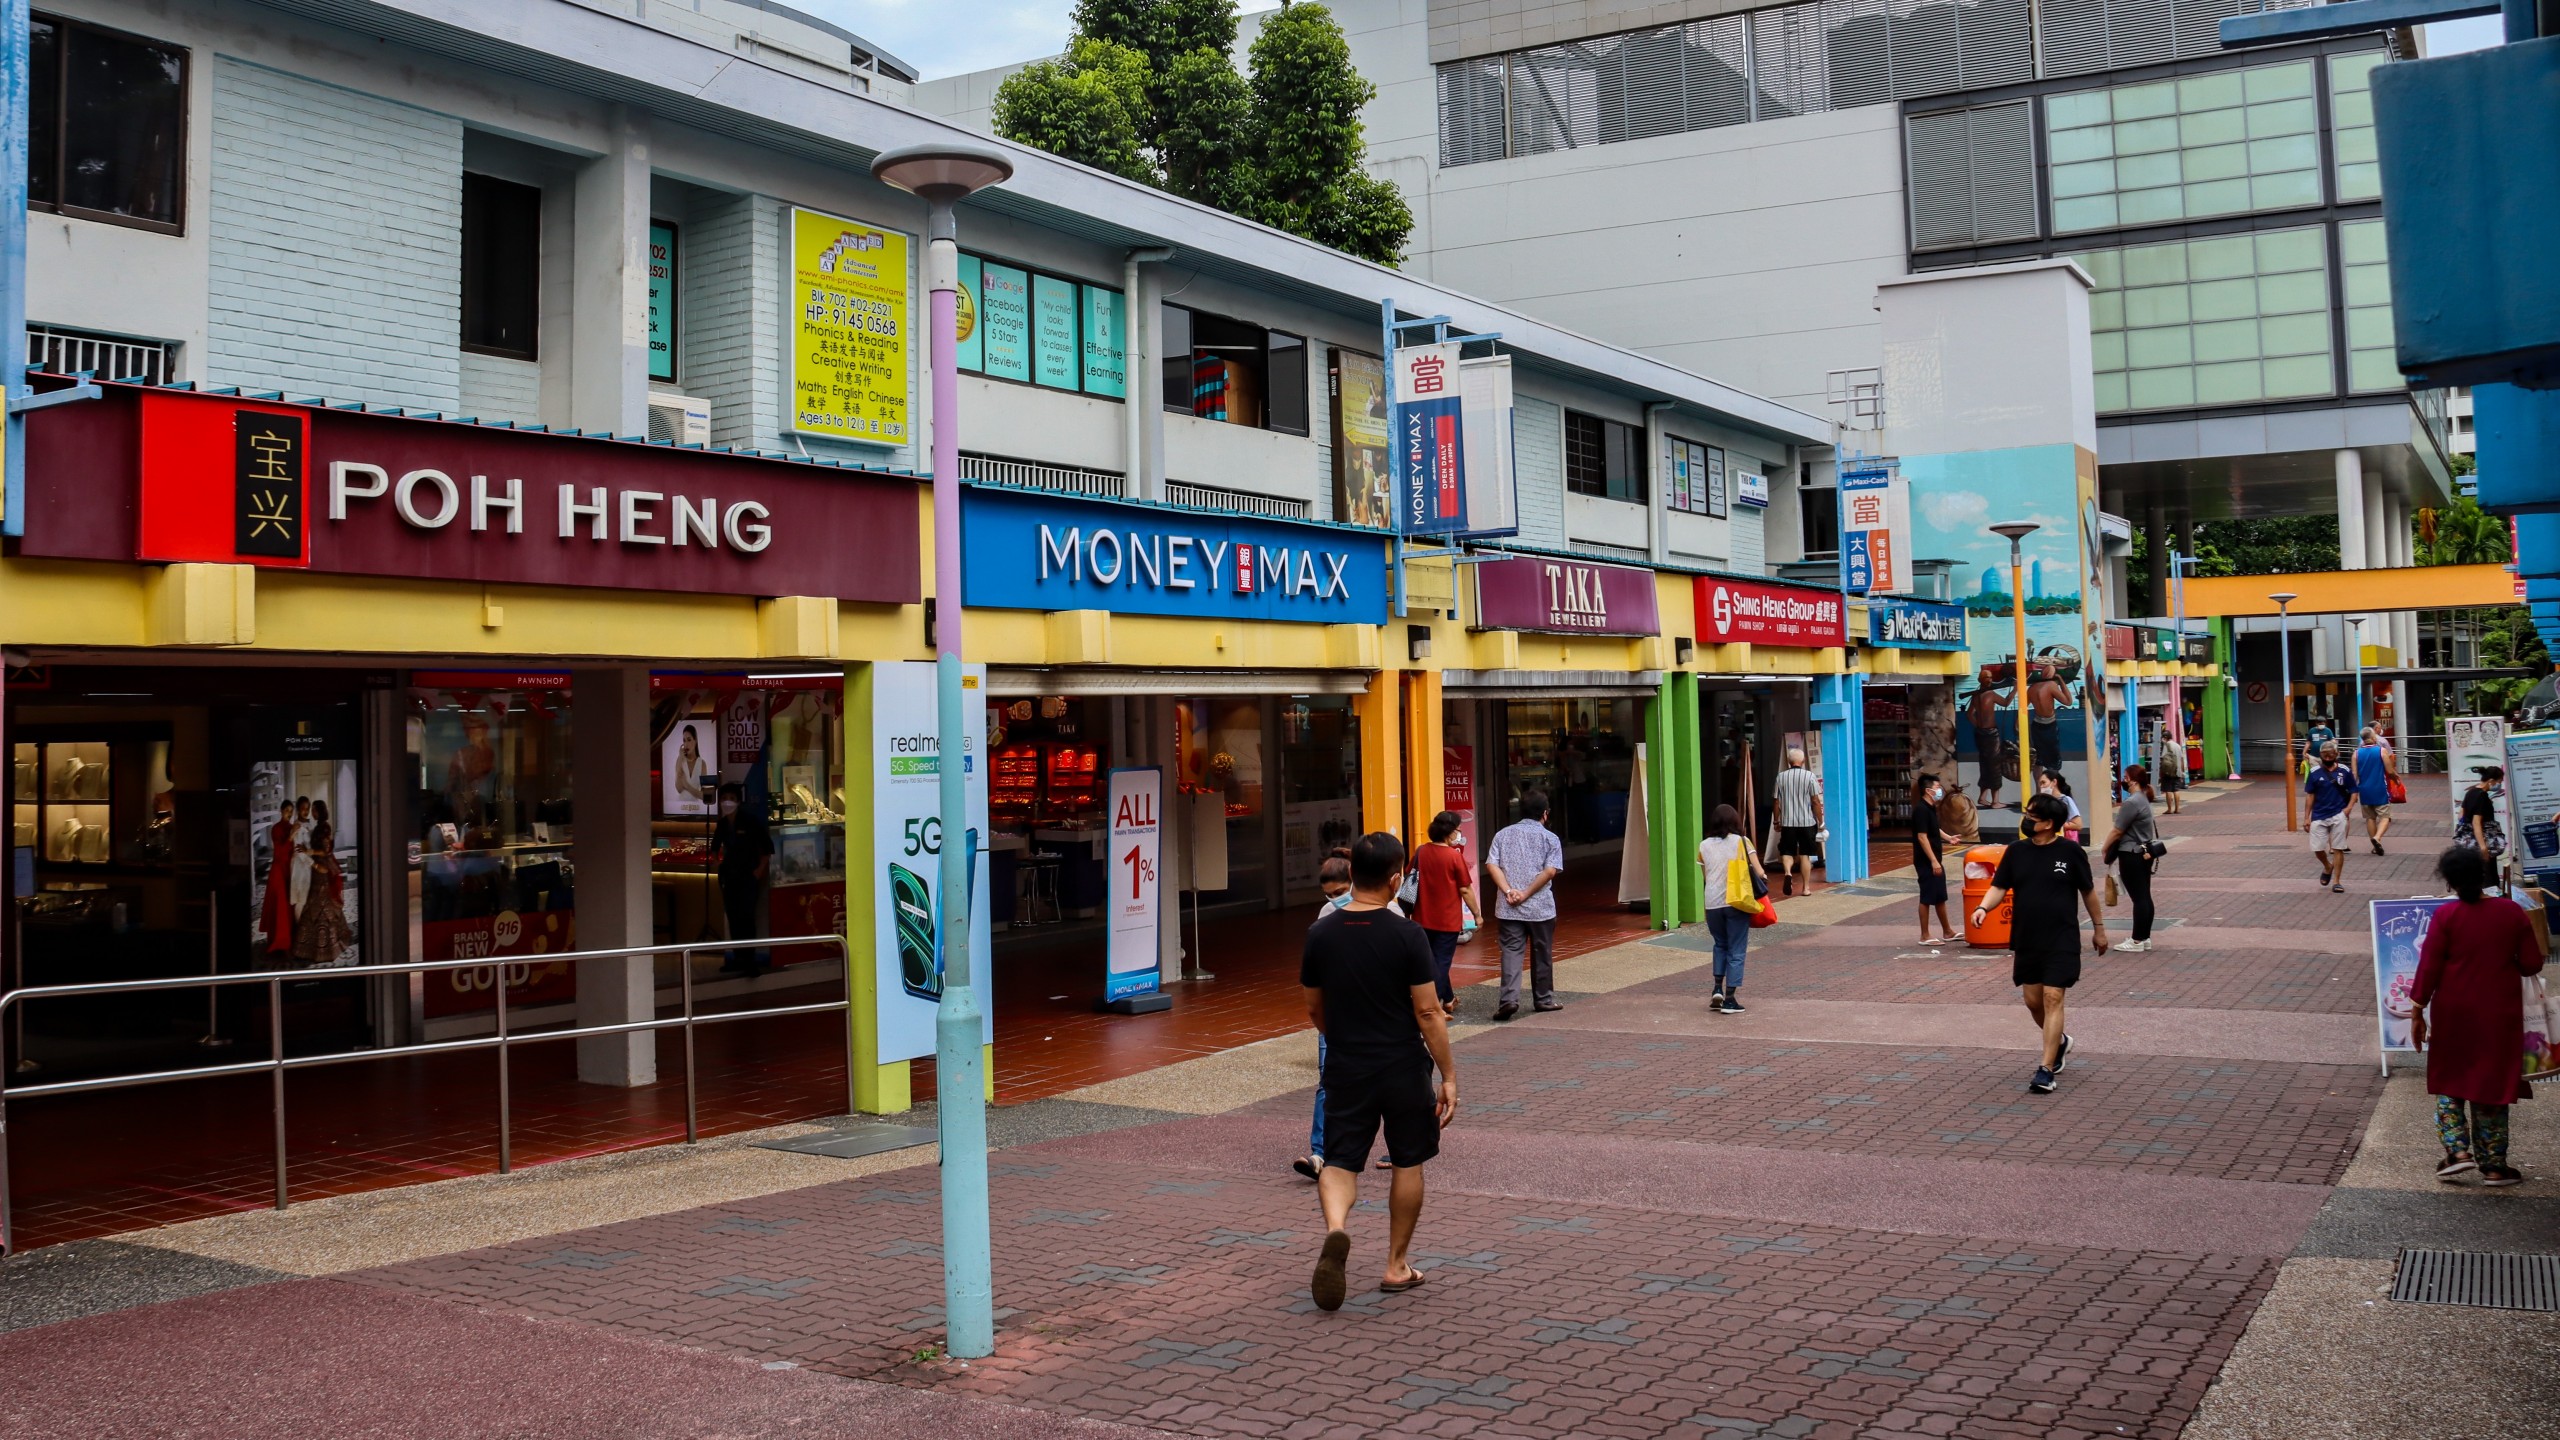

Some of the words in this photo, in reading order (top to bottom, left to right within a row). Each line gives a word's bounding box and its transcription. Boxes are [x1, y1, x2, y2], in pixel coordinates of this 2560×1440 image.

[842, 266, 878, 279] Montessori
[844, 258, 877, 270] Advanced
[797, 269, 905, 298] www.ami-phonics.com/amk
[995, 276, 1024, 295] Google
[812, 289, 825, 303] Blk
[829, 293, 846, 308] 702
[850, 297, 892, 316] #02-2521
[983, 295, 1025, 314] Facebook
[1055, 303, 1072, 315] child
[1096, 302, 1112, 317] Fun
[806, 304, 828, 323] HP:
[833, 309, 863, 329] 9145
[867, 316, 896, 336] 0568
[984, 312, 991, 322] &
[993, 313, 1024, 331] Google
[1046, 315, 1064, 326] looks
[804, 322, 844, 341] Phonics
[847, 331, 855, 342] &
[858, 333, 899, 353] Reading
[992, 328, 997, 340] 5
[998, 329, 1018, 344] Stars
[1043, 326, 1070, 340] forward
[1101, 325, 1108, 336] &
[820, 340, 885, 363] 英语发音与阅读
[1041, 339, 1048, 348] to
[1049, 339, 1072, 353] classes
[1086, 341, 1123, 360] Effective
[811, 352, 856, 370] Creative
[859, 361, 892, 379] Writing
[988, 353, 1022, 370] Reviews
[1046, 354, 1066, 365] every
[834, 371, 871, 387] 创意写作
[1086, 363, 1123, 384] Learning
[1411, 354, 1445, 394] 當
[797, 380, 827, 394] Maths
[832, 385, 864, 400] English
[868, 391, 904, 406] Chinese
[806, 395, 826, 410] 数学
[843, 402, 860, 415] 英语
[879, 406, 896, 420] 华文
[799, 410, 823, 426] Ages
[825, 413, 831, 423] 3
[834, 415, 843, 427] to
[870, 420, 879, 433] 至
[1409, 412, 1423, 453] MAX
[248, 429, 293, 540] 宝兴
[1852, 476, 1888, 486] Maxi-Cash
[1411, 462, 1425, 525] MONEY
[329, 459, 523, 534] POH
[558, 483, 772, 552] HENG
[1853, 495, 1880, 525] 當
[1037, 523, 1228, 590] MONEY
[1258, 546, 1349, 598] MAX
[1850, 537, 1866, 586] 大興當
[1546, 564, 1606, 614] TAKA
[1733, 591, 1760, 617] SHING
[1762, 595, 1786, 619] HENG
[1787, 598, 1814, 621] GROUP
[1550, 613, 1606, 627] JEWELLERY
[1752, 621, 1765, 631] SHOP
[1895, 609, 1943, 640] Maxi-Cash
[517, 677, 564, 685] PAWNSHOP
[728, 723, 760, 736] GOLD
[1057, 724, 1076, 734] TAKA
[728, 737, 760, 750] PRICE
[891, 759, 907, 774] 5G.
[908, 758, 935, 776] Speed
[1445, 769, 1468, 777] Greatest
[1445, 777, 1469, 786] SALE
[1446, 791, 1469, 801] TAKA
[1115, 793, 1156, 828] ALL
[904, 817, 942, 856] 5G
[1123, 844, 1155, 900] 1%
[454, 930, 489, 944] BRAND
[497, 920, 519, 935] 916
[454, 941, 489, 959] NEW
